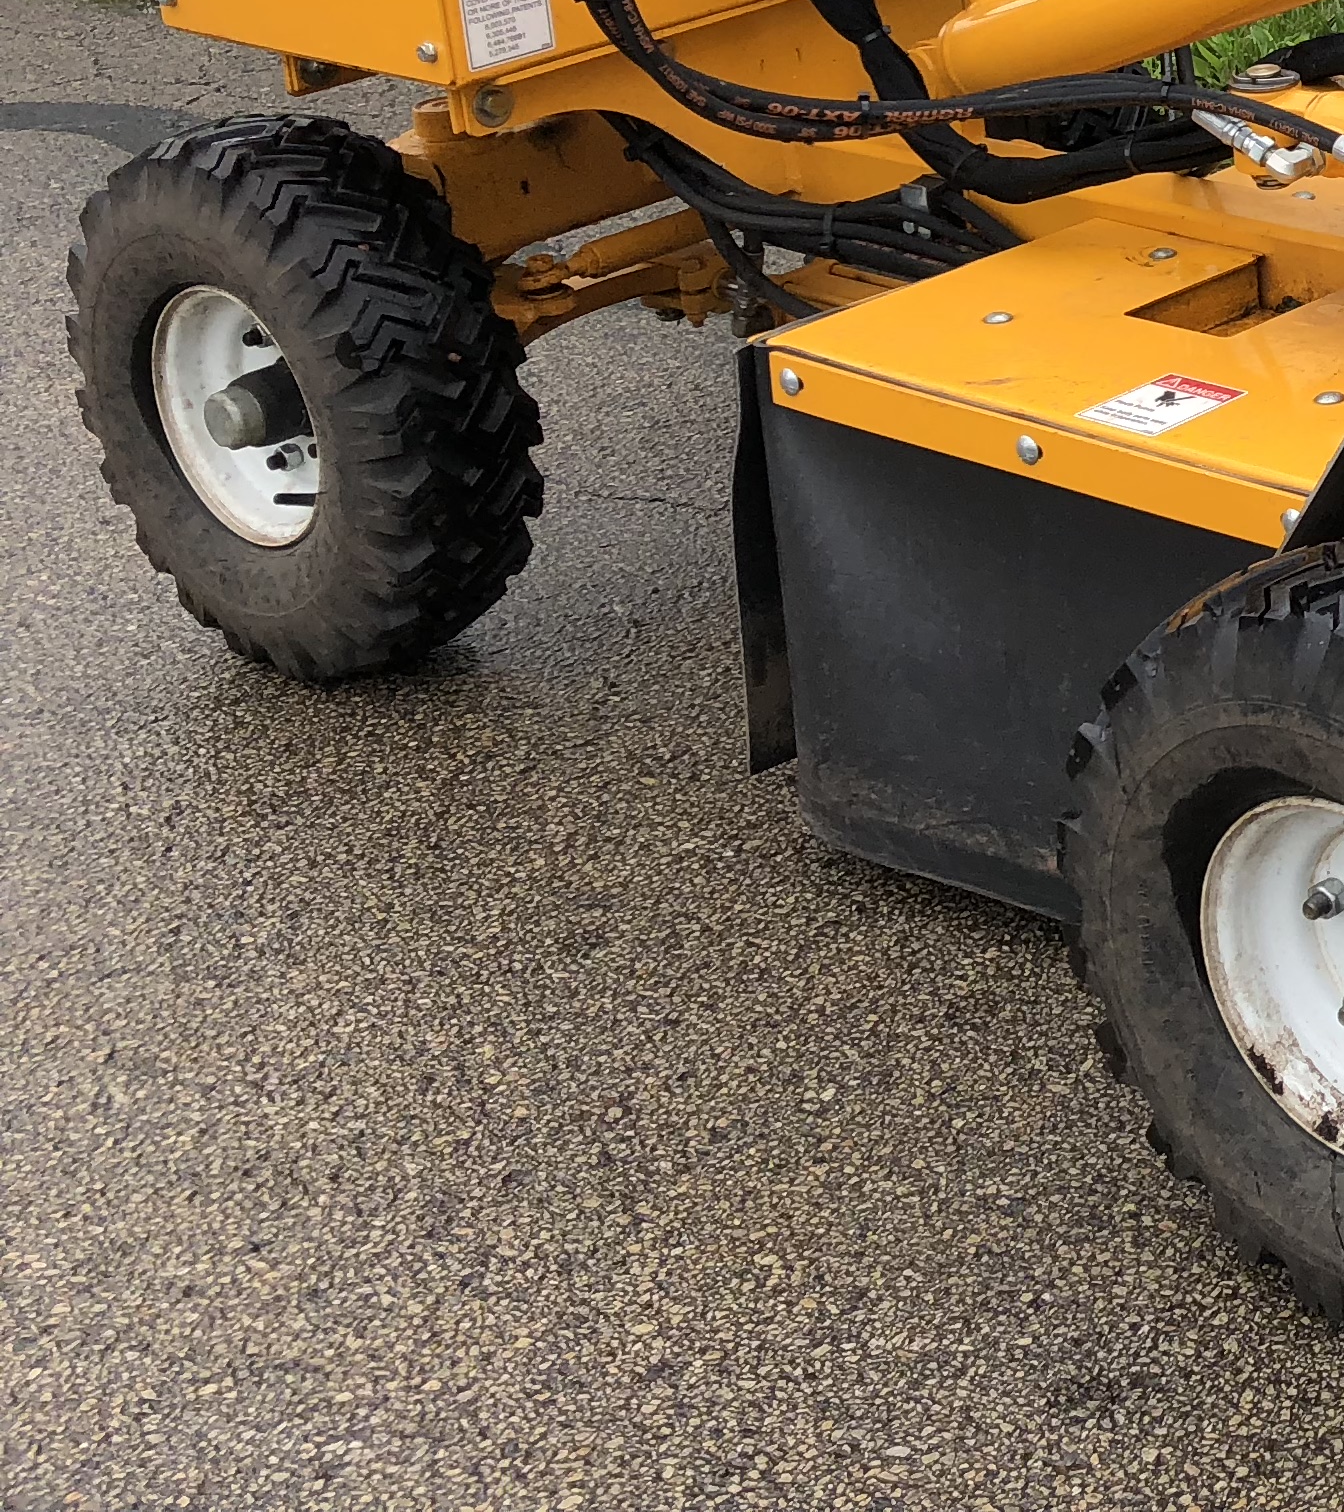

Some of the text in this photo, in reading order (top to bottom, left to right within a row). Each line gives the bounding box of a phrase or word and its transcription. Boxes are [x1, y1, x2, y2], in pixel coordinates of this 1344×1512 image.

[480, 1, 500, 13] MORE
[468, 9, 509, 25] FOLLOWING
[767, 102, 862, 122] AXT-06
[1229, 106, 1256, 120] MSHA
[1300, 131, 1320, 146] SAE
[1176, 383, 1232, 402] DANGER
